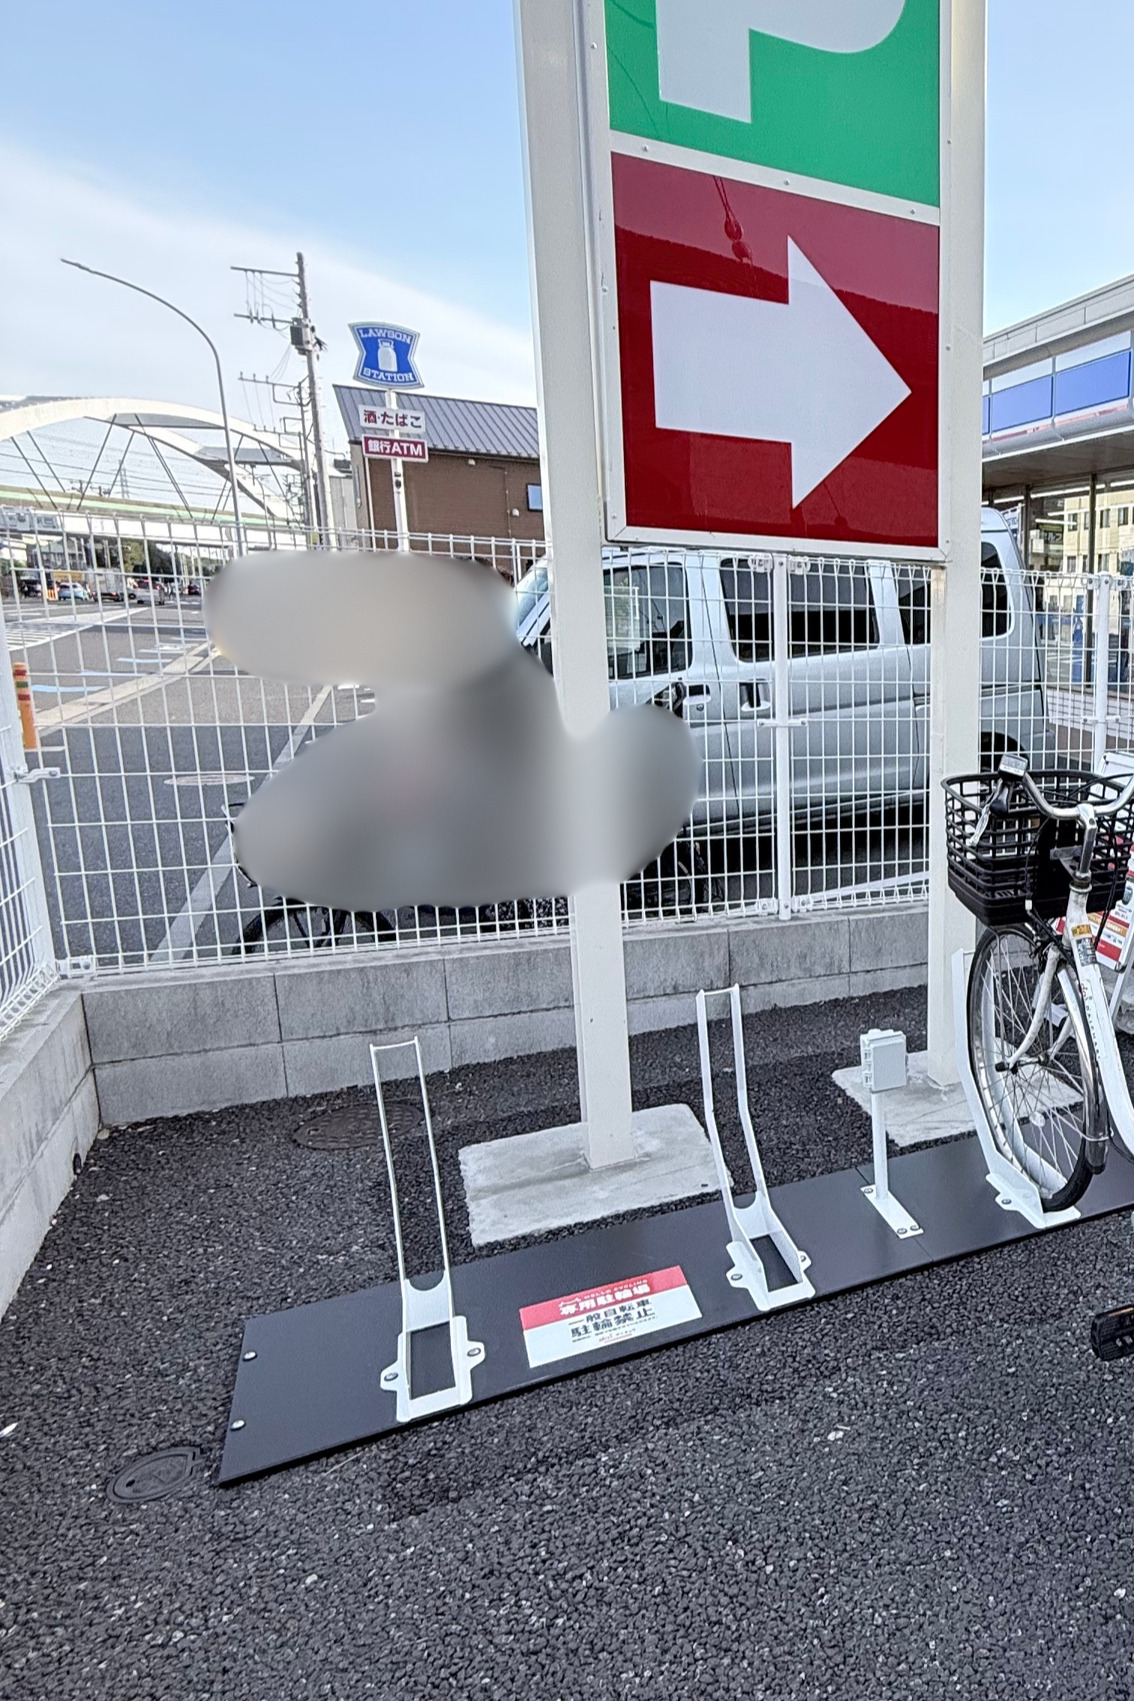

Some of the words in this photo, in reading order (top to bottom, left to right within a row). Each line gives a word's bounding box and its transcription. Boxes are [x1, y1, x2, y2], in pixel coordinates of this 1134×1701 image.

[359, 328, 412, 344] LAWSON
[362, 367, 414, 382] STATION
[367, 439, 423, 456] 銀行ATM
[568, 1298, 652, 1326] 一般自転車
[571, 1307, 656, 1338] 駐輪禁止
